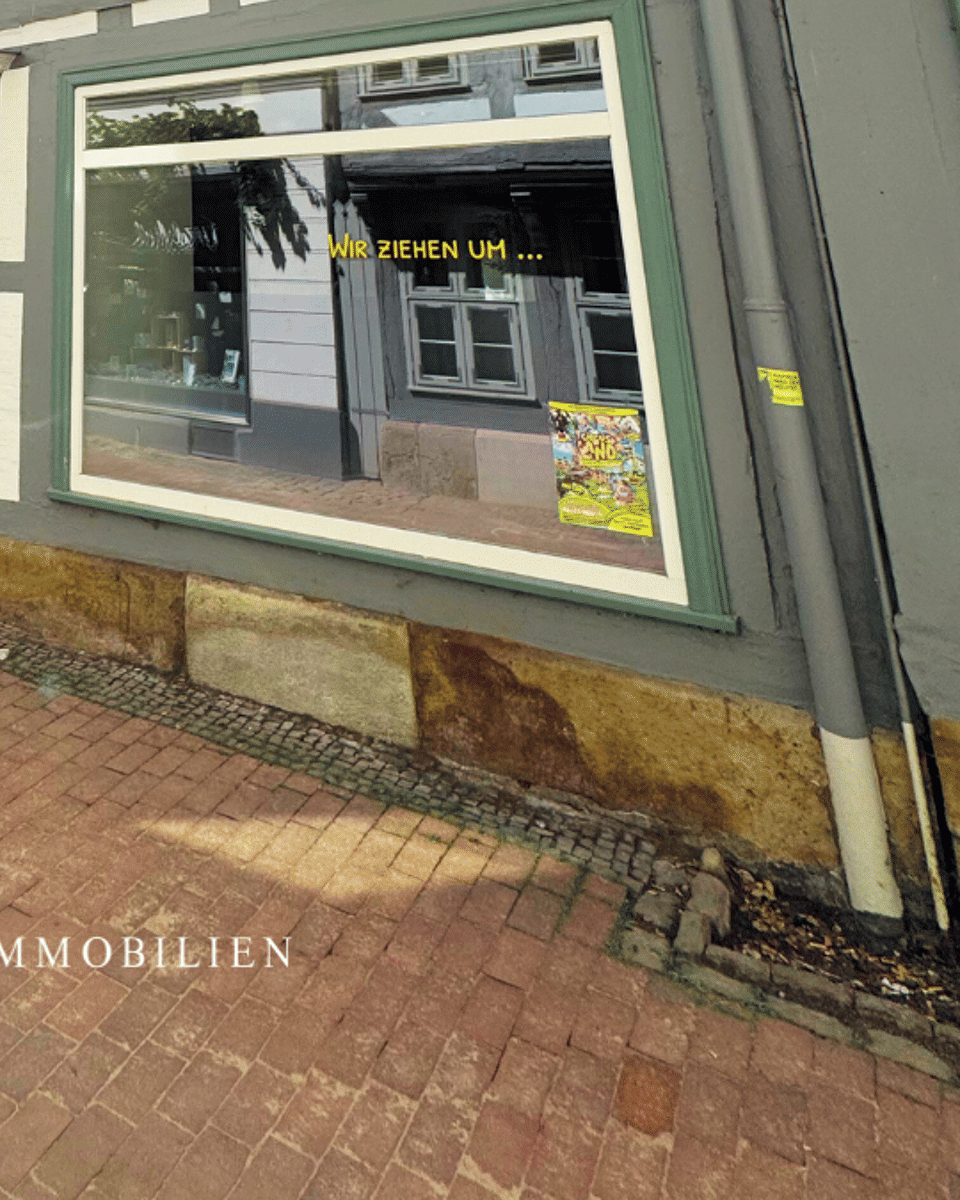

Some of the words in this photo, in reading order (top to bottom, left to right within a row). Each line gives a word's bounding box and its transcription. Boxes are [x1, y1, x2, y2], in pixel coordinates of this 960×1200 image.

[328, 233, 368, 259] WIR
[377, 239, 459, 260] ZIEHEN
[468, 238, 507, 260] UM
